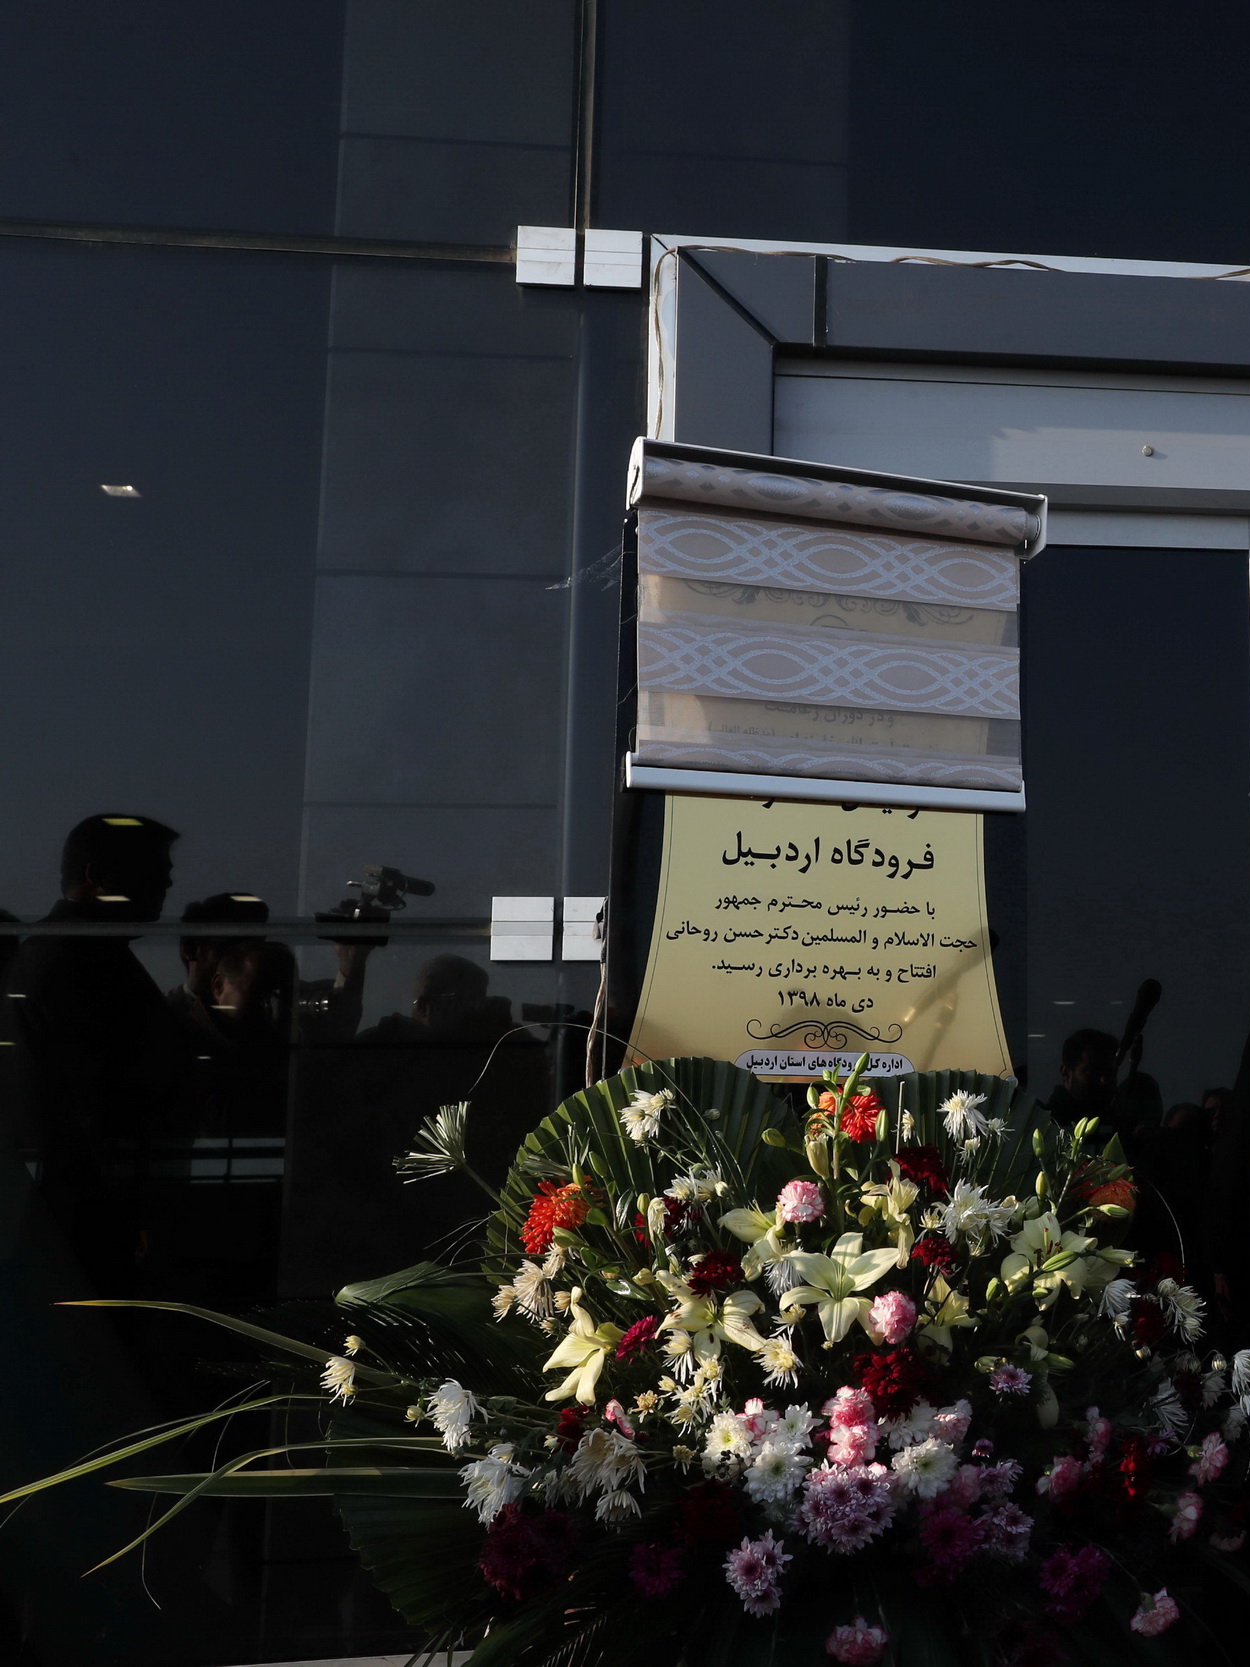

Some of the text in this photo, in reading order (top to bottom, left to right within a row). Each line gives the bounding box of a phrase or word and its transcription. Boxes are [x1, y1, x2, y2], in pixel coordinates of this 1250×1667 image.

[722, 831, 934, 879] فرودگاه اردبیل
[715, 895, 935, 919] با حضور رئیس محترم جمهور
[666, 921, 977, 952] حجت الاسلام و المسلمین دکتر حسن روحانی
[712, 959, 936, 983] افتتاح و به بهره برداری رسید.
[778, 991, 873, 1013] دی ماه ۱۳۹۸
[747, 1055, 777, 1070] اردبیل
[780, 1055, 805, 1070] استان
[808, 1056, 826, 1070] های
[882, 1058, 902, 1072] اداره
